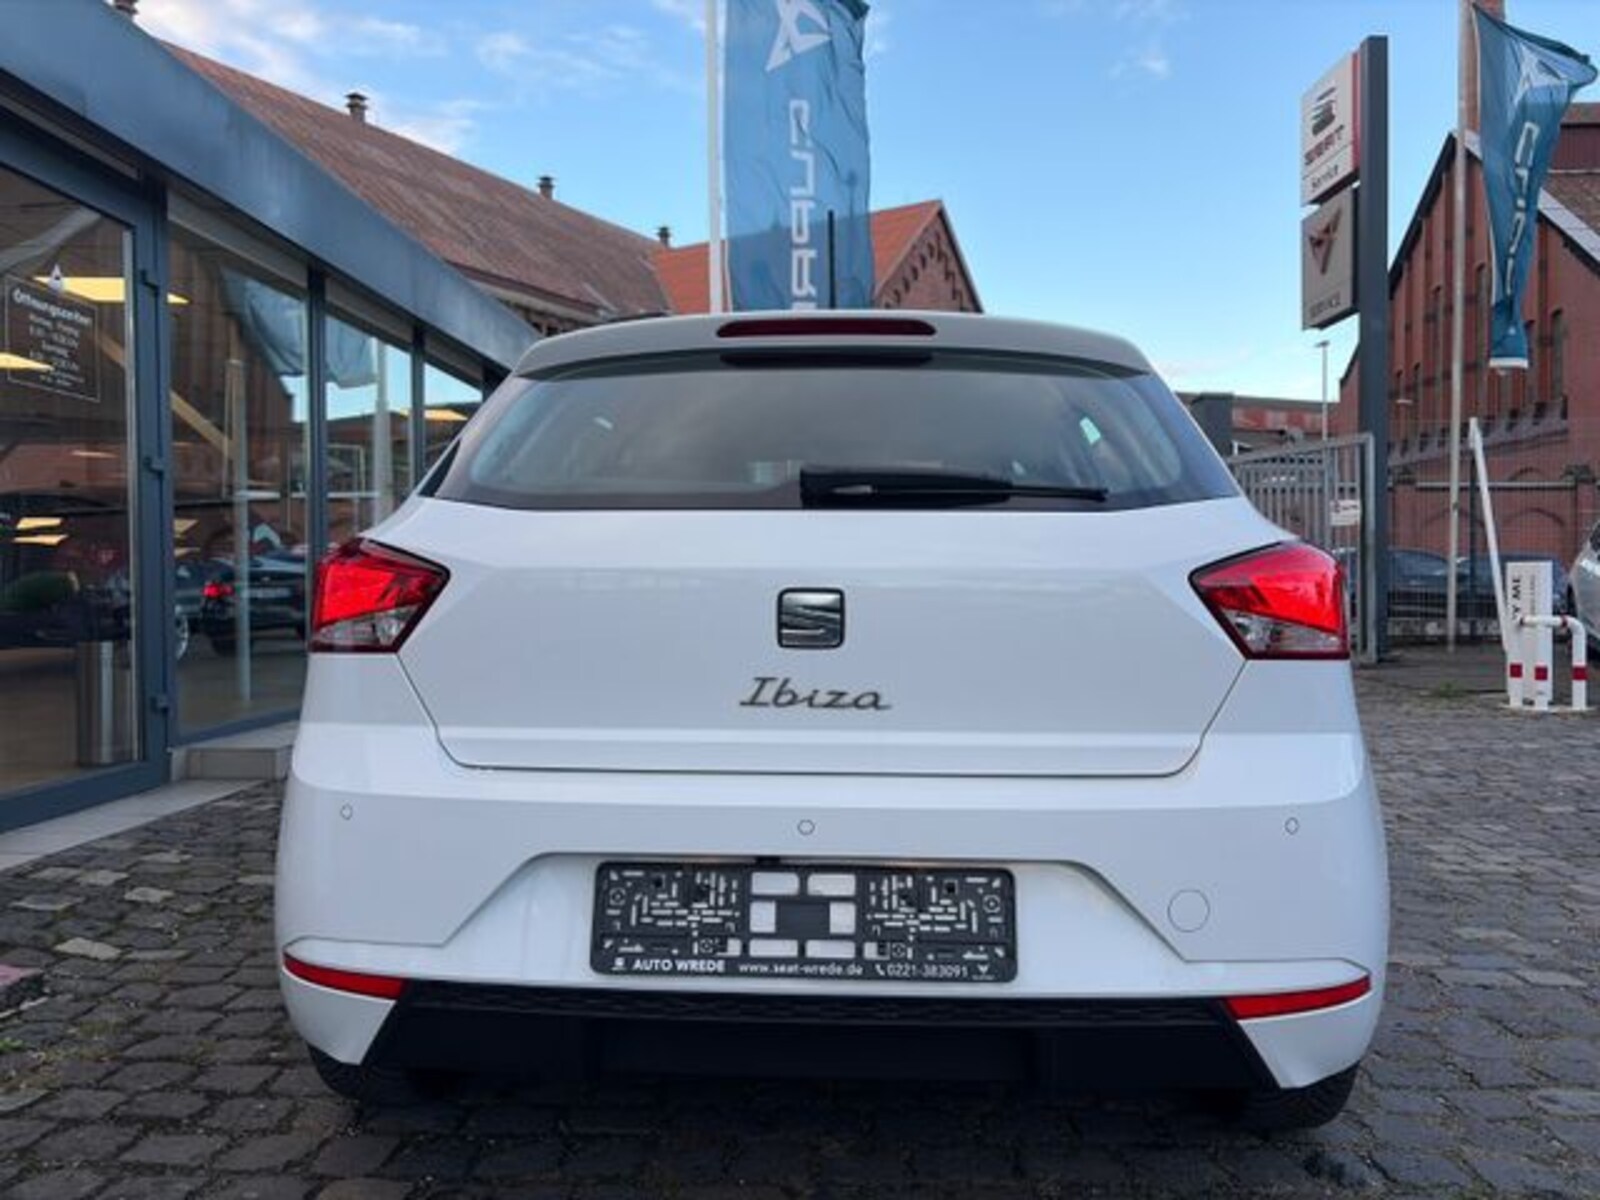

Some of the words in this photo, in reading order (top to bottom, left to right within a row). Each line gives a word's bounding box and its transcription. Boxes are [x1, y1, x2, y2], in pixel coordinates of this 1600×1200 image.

[740, 677, 892, 711] Ibiza
[632, 958, 673, 972] AUTO
[675, 958, 726, 974] WREDE
[739, 962, 864, 977] www.seat-wrede.de
